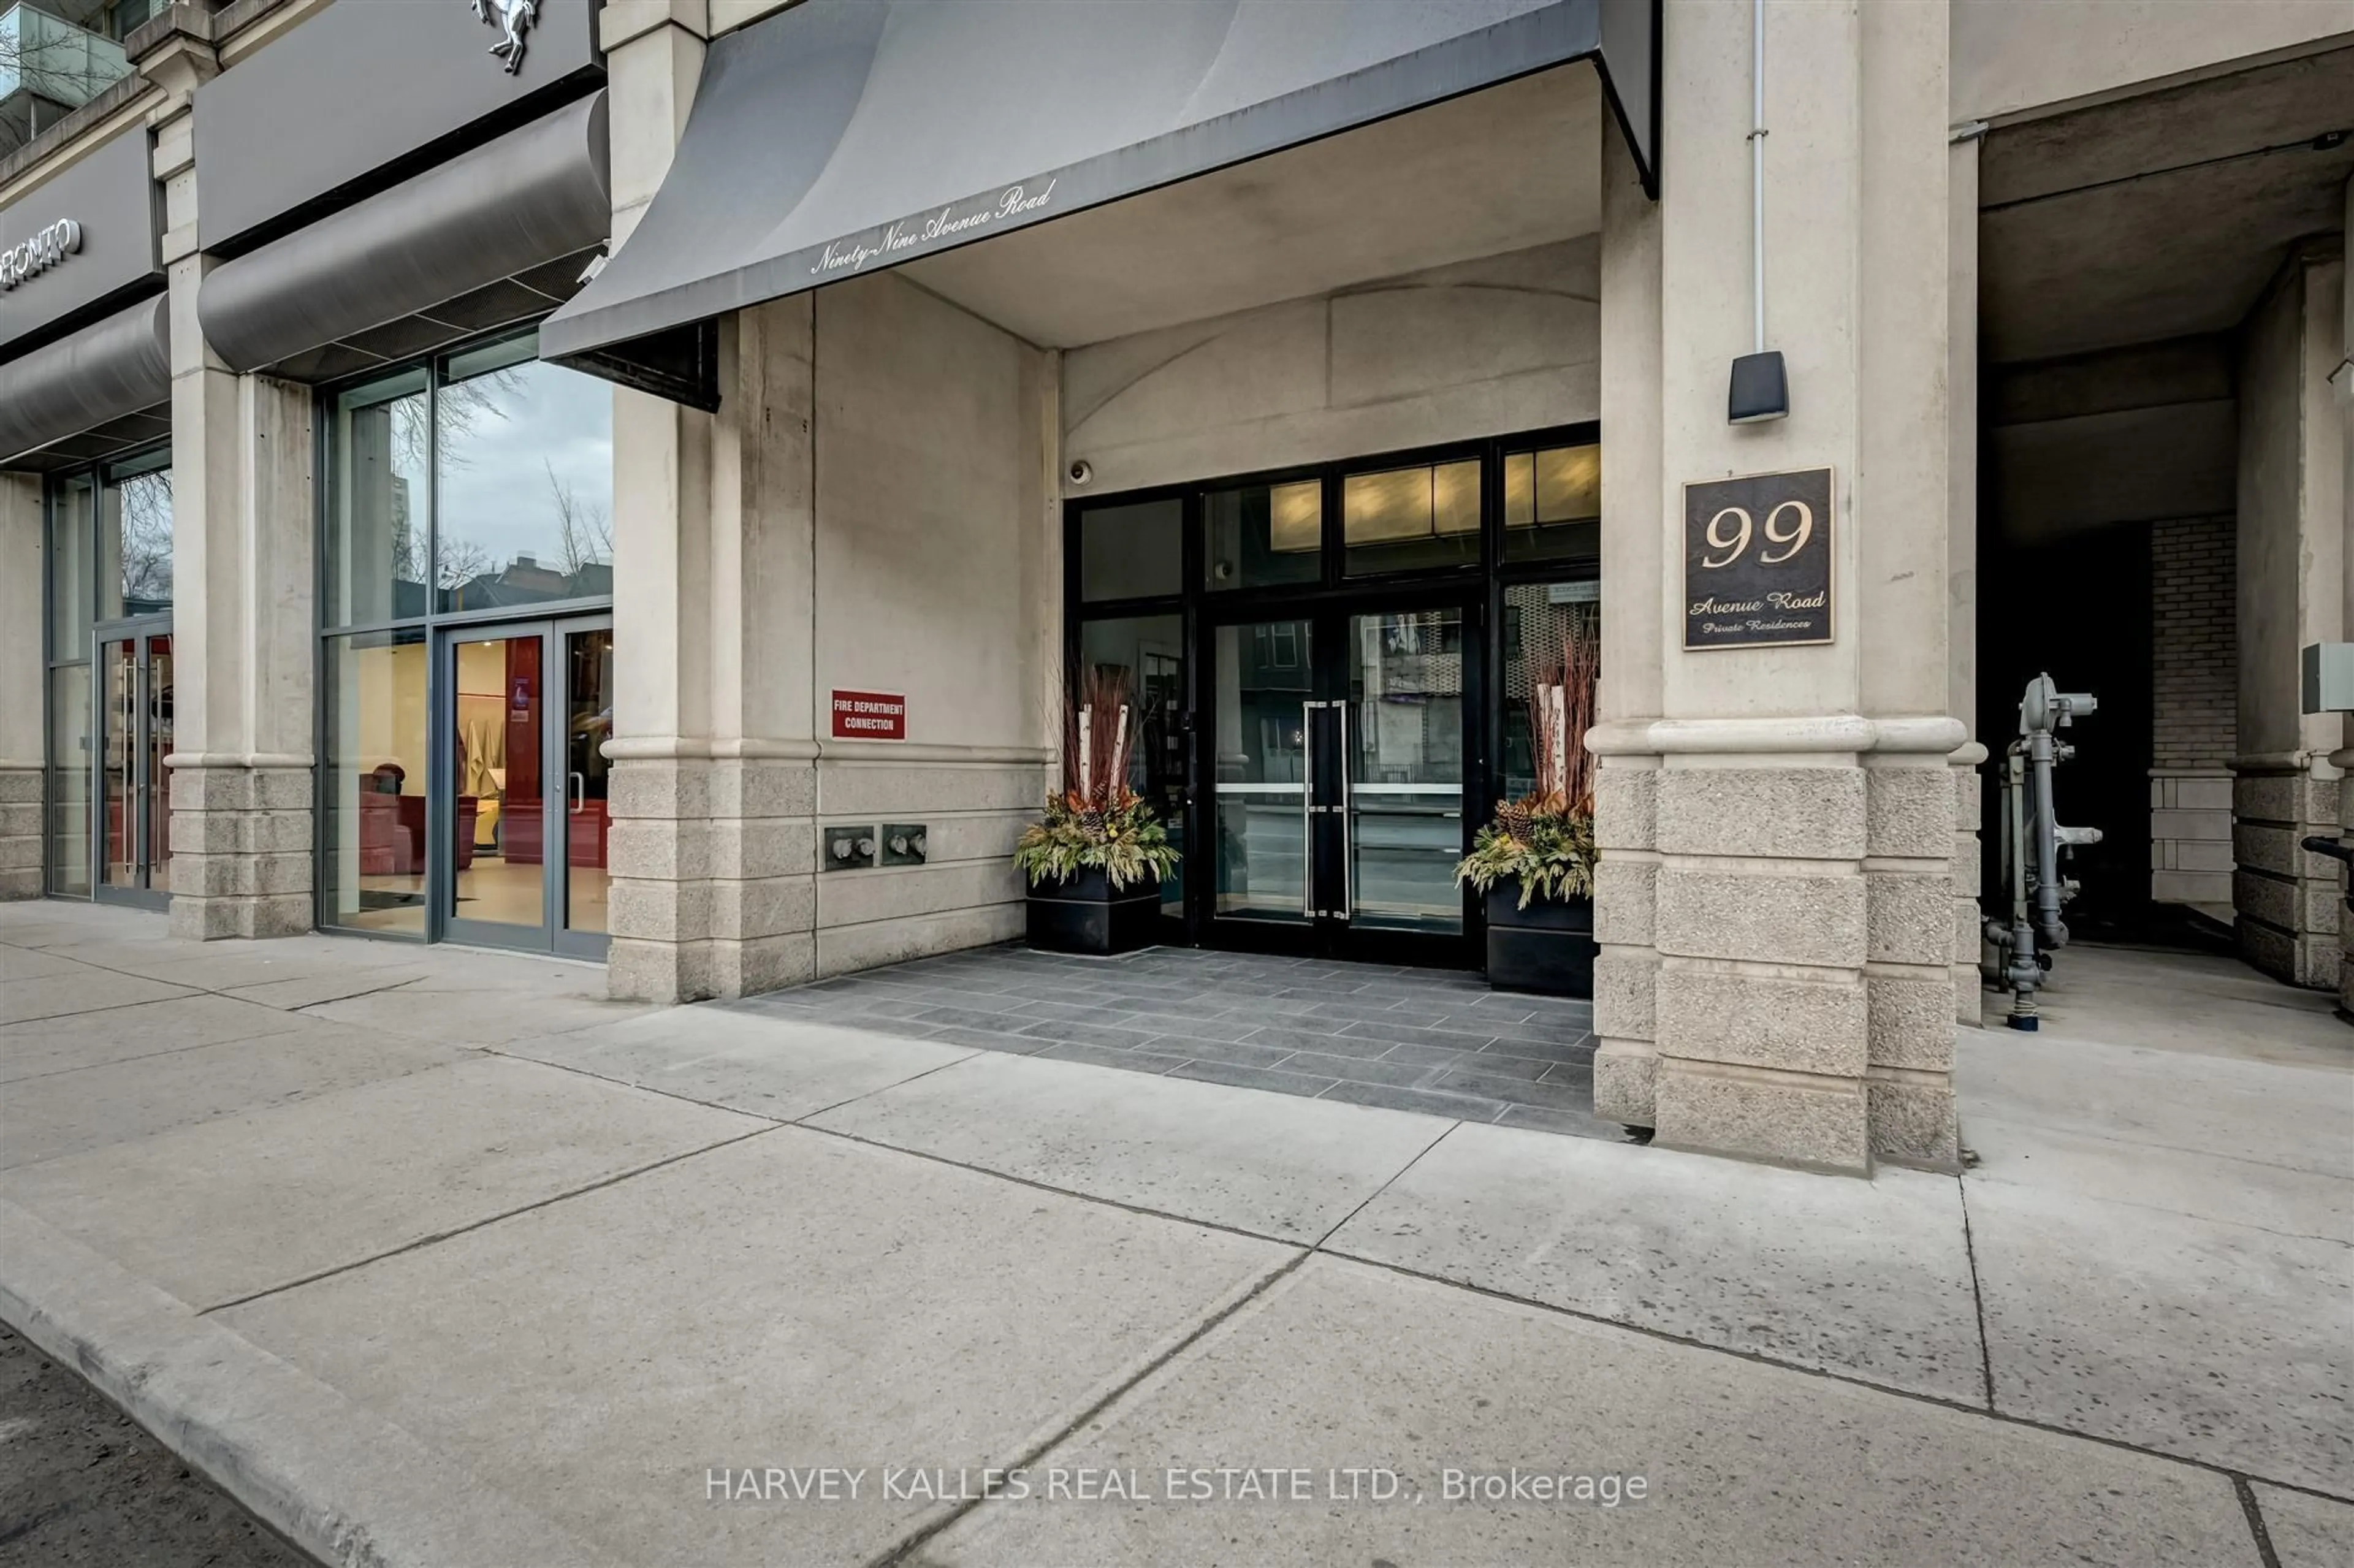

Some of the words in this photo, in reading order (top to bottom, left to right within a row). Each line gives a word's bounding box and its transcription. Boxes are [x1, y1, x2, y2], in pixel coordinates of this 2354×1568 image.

[810, 219, 918, 275] Ninety-Nine
[921, 207, 991, 242] Avenue
[995, 178, 1057, 219] Road
[0, 218, 80, 284] RONTO
[1701, 500, 1813, 568] 99
[1689, 597, 1764, 615] Avenue
[1767, 590, 1826, 609] Road
[1703, 622, 1744, 634] Private
[1746, 619, 1811, 631] Residences
[834, 699, 853, 712] FIRE
[854, 701, 904, 716] DEPARTMENT
[845, 717, 894, 731] CONNECTION
